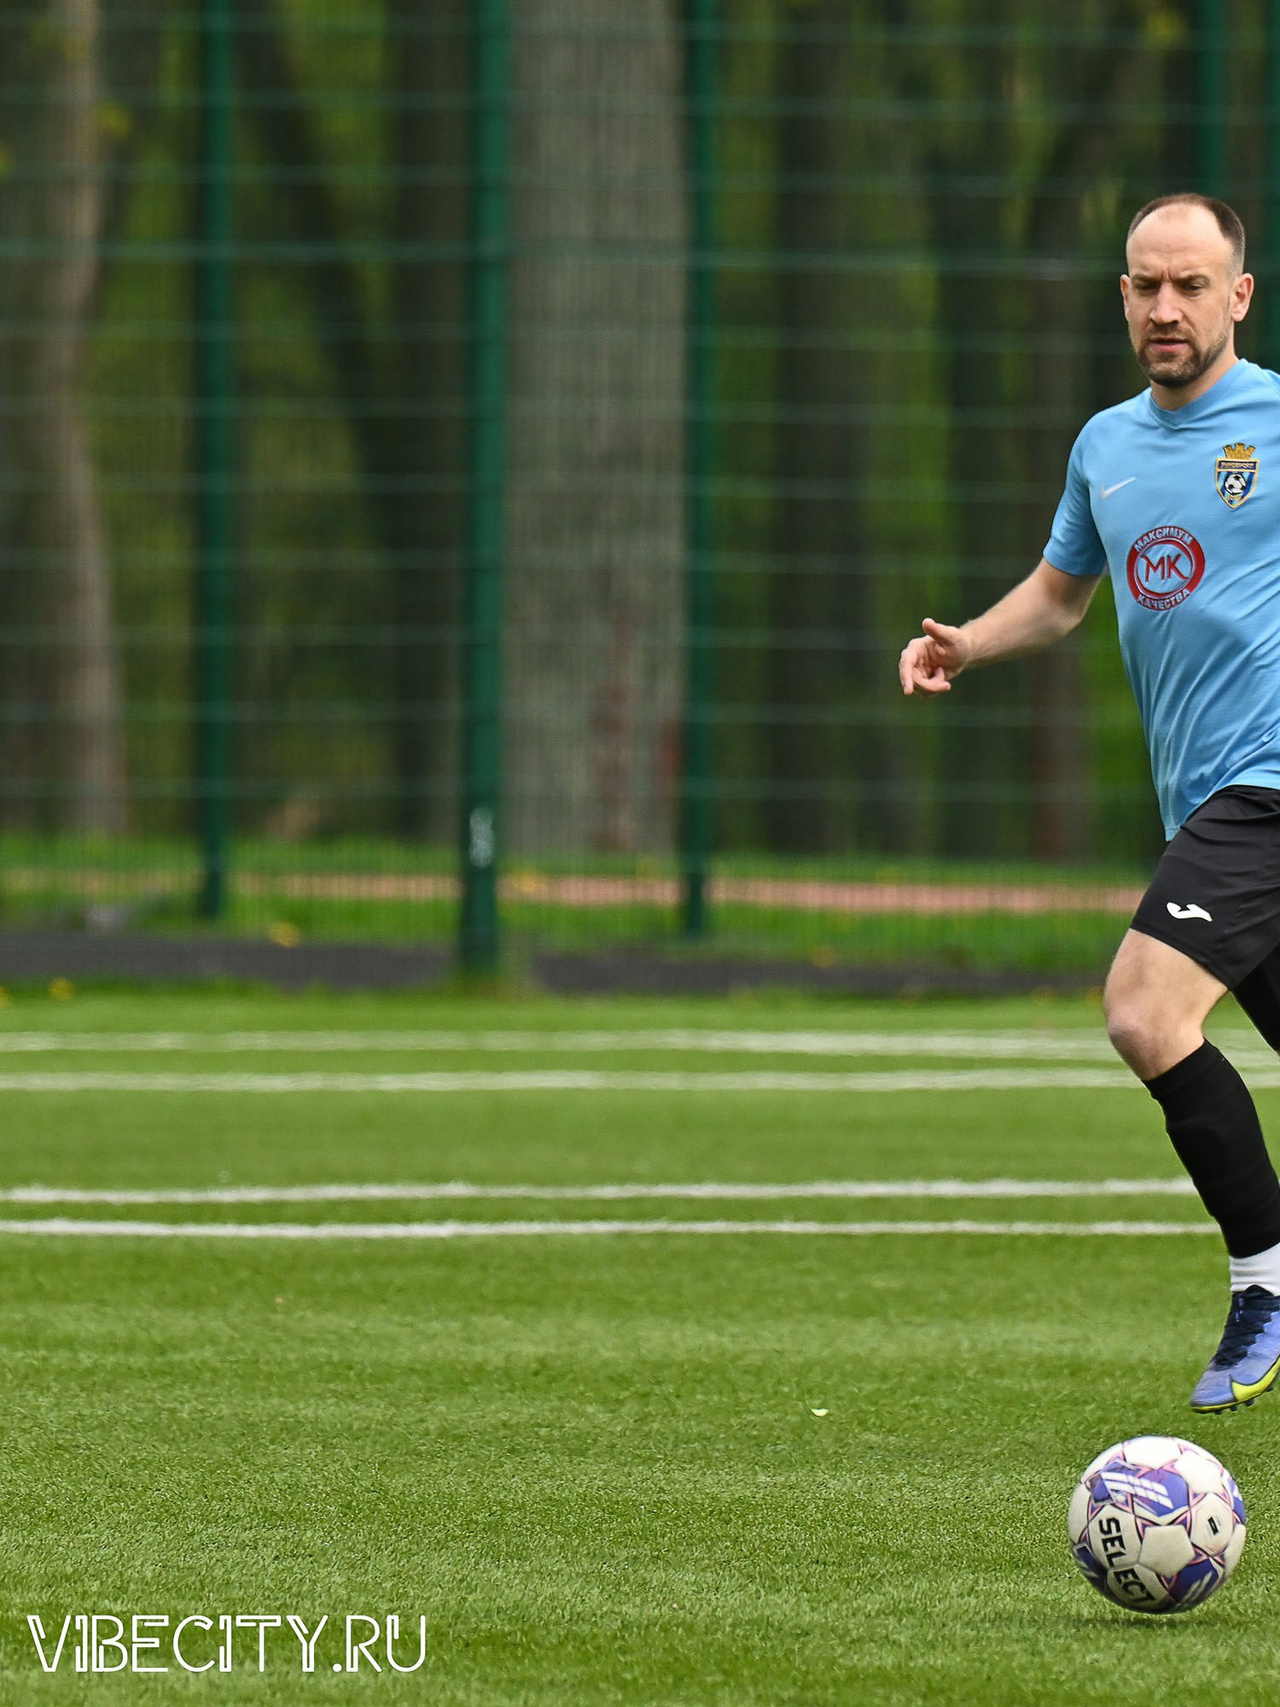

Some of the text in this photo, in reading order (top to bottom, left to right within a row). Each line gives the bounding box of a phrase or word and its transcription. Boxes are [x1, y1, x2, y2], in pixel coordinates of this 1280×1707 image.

[1134, 527, 1193, 553] МАКСИМУМ
[1137, 588, 1191, 610] КАЧЕСТВА
[1098, 1516, 1157, 1601] SELECT
